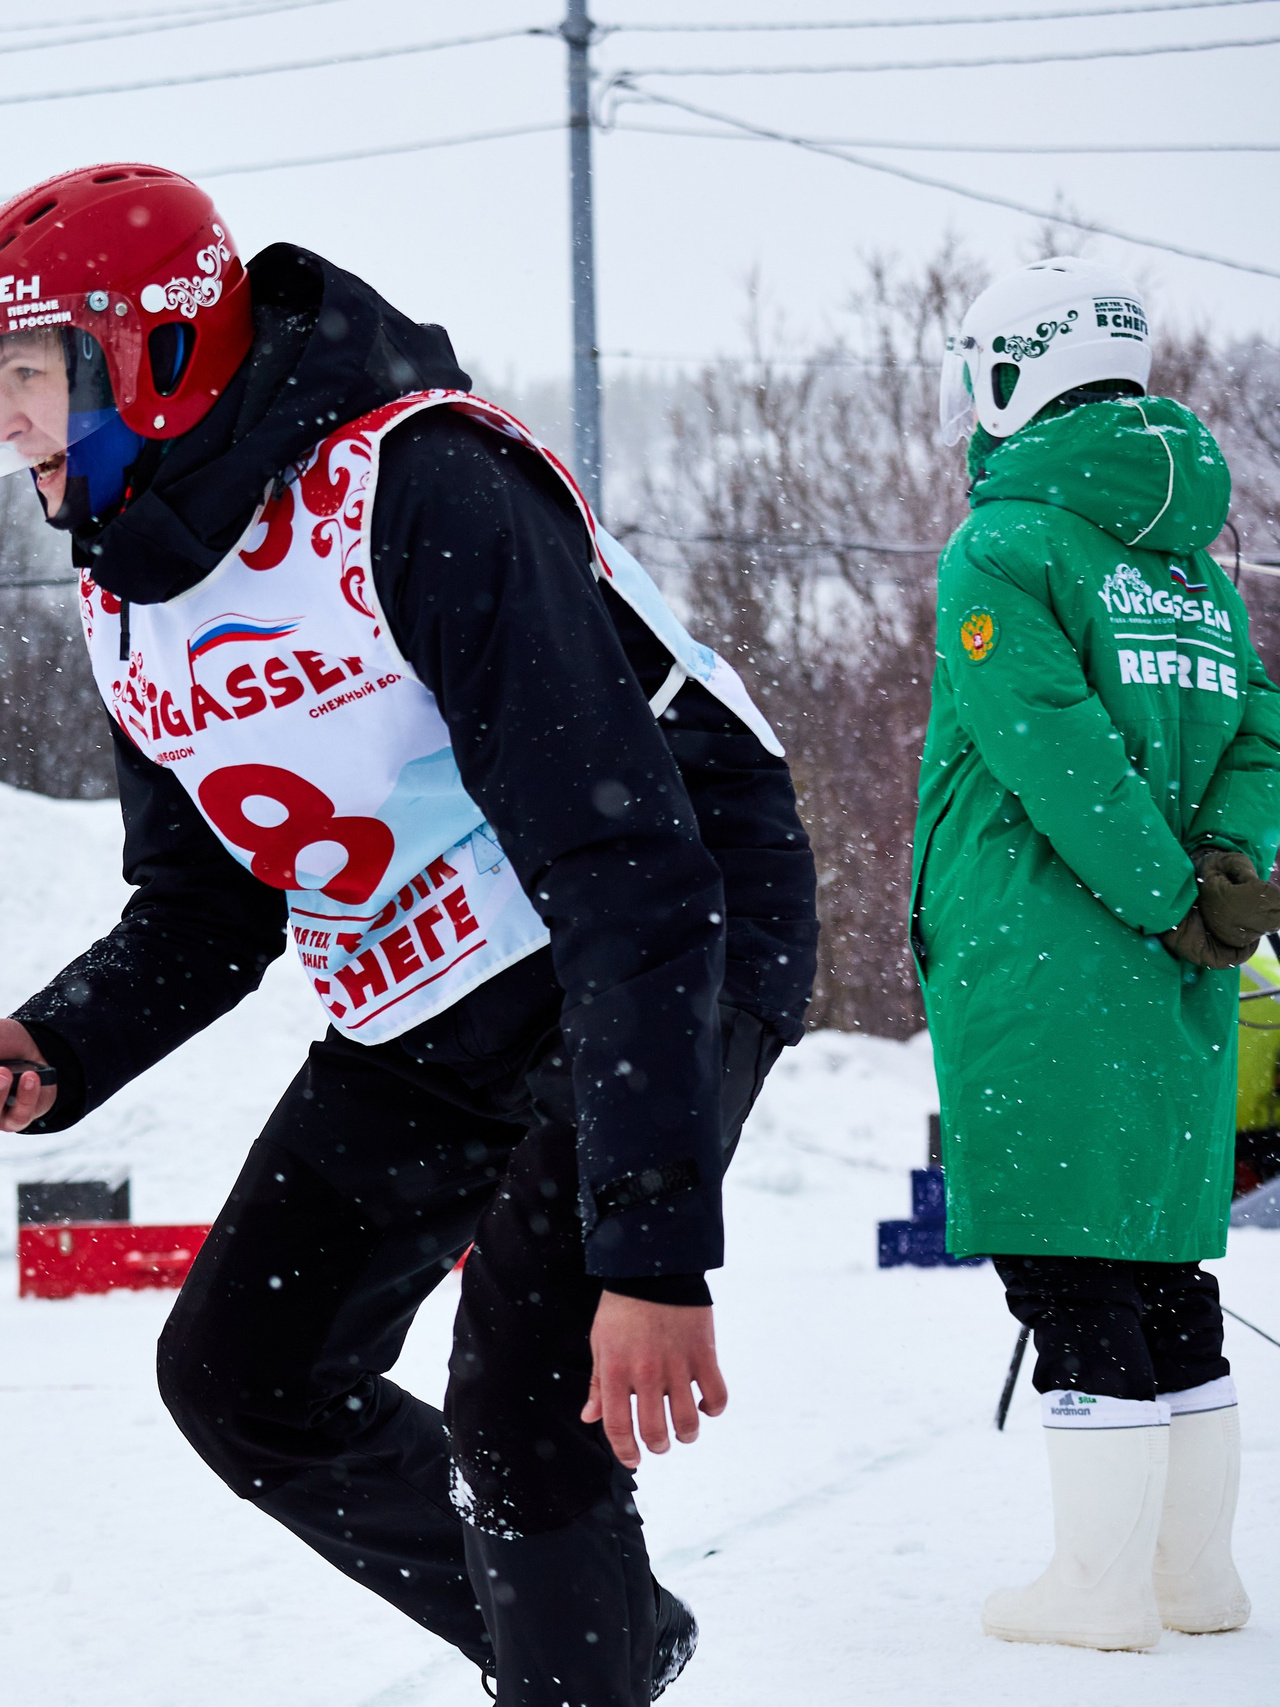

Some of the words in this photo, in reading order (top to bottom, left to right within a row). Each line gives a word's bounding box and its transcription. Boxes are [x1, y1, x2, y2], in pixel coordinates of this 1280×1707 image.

[7, 299, 59, 317] ПЕРВЫЕ
[9, 320, 18, 331] В
[20, 311, 72, 329] РОССИИ
[1096, 314, 1108, 328] В
[308, 681, 377, 719] СНЕЖНЫЙ
[197, 763, 395, 905] 8
